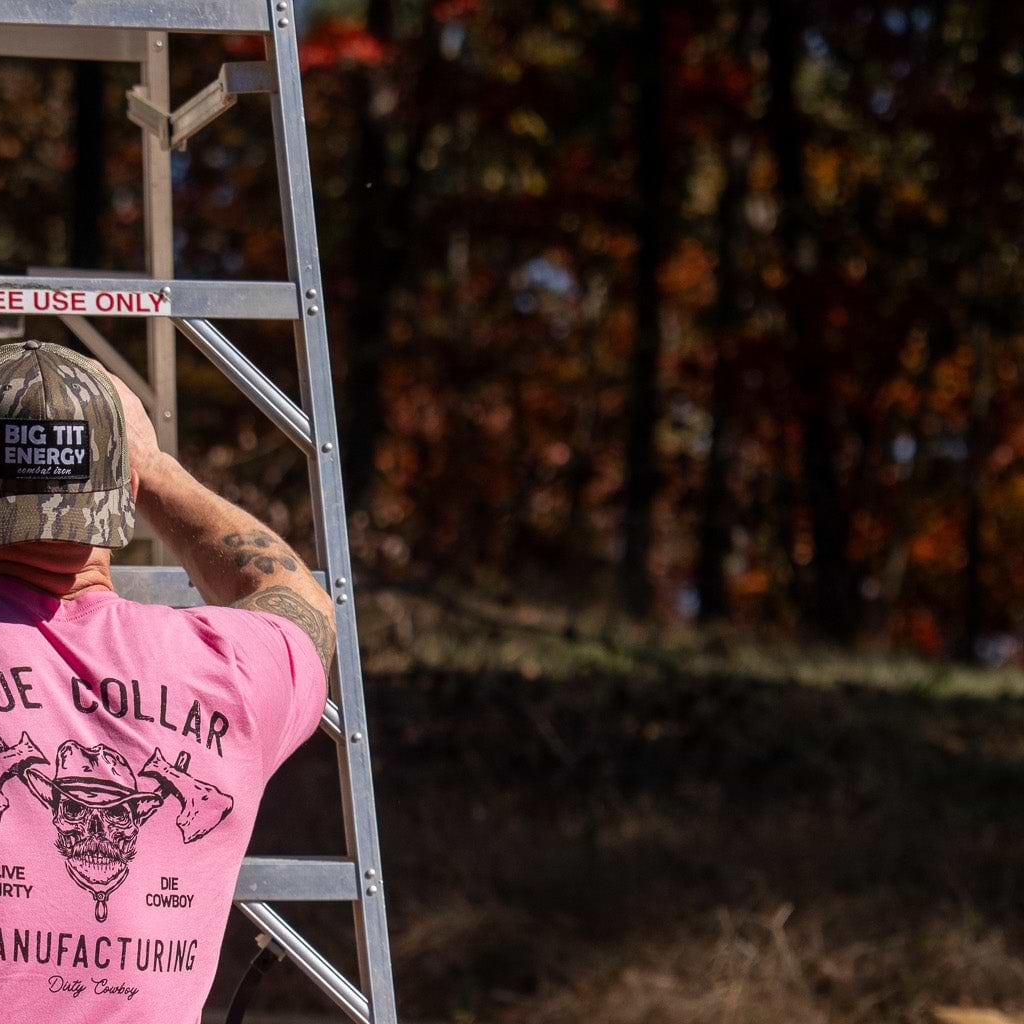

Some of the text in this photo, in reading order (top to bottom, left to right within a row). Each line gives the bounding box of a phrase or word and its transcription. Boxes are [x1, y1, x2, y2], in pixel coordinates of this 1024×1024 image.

[33, 290, 86, 312] USE
[95, 292, 164, 313] ONLY
[4, 424, 85, 445] BIG TIT
[4, 447, 85, 465] ENERGY
[71, 676, 229, 757] COLLAR
[160, 877, 179, 891] DIE
[145, 894, 194, 908] COWBOY
[48, 975, 139, 1000] Dirty Cowboy
